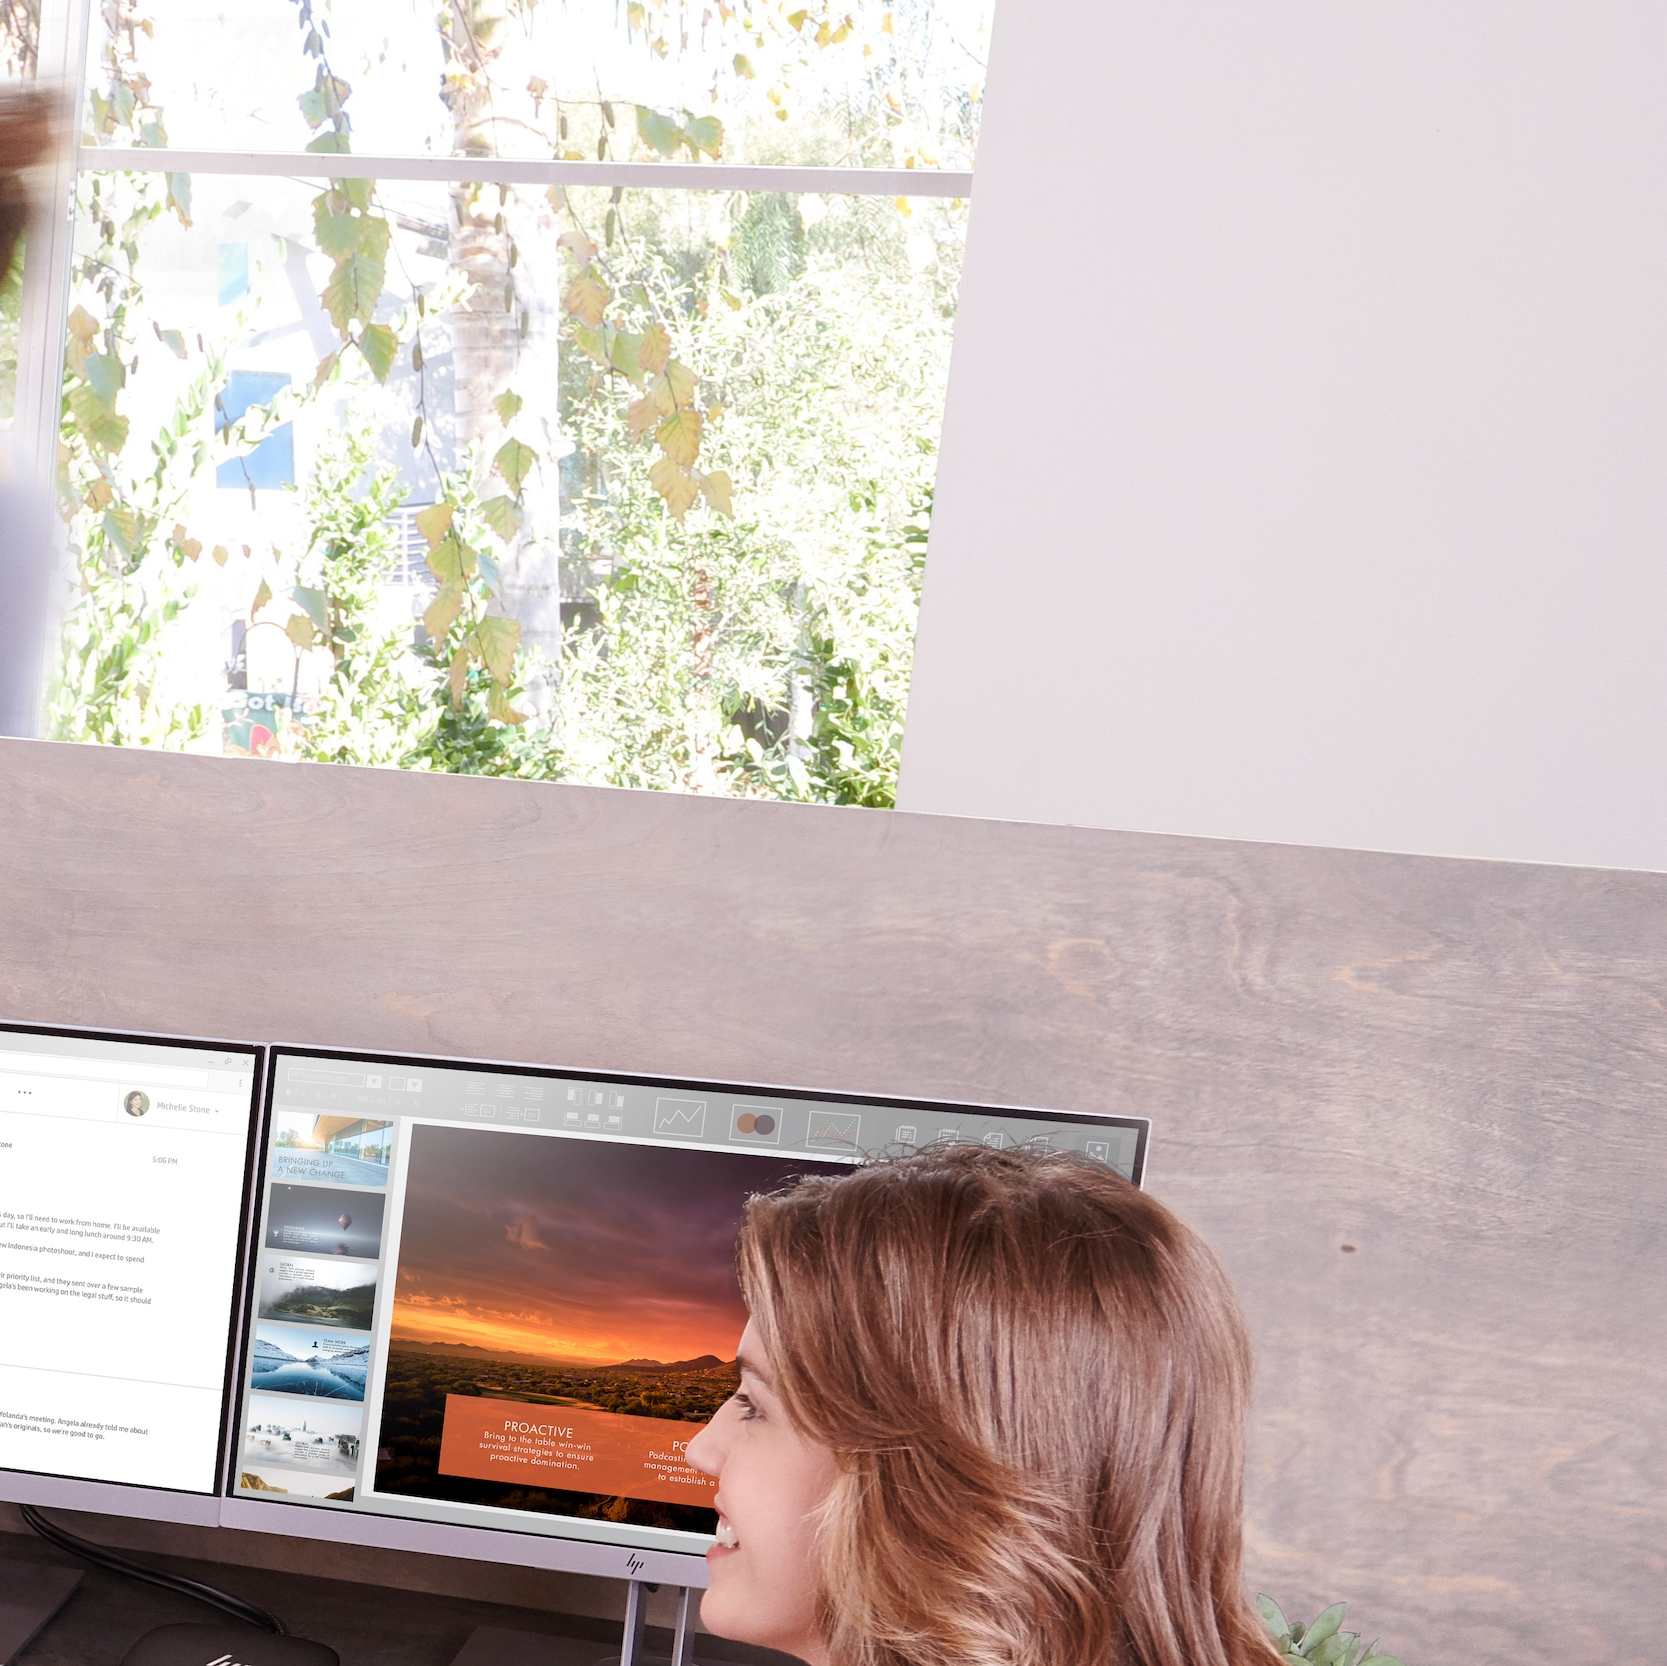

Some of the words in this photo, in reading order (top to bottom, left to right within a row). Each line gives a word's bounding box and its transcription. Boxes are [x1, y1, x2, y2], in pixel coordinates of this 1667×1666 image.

[157, 1101, 187, 1112] Michelle
[189, 1104, 211, 1114] Stone
[152, 1156, 167, 1164] 5:06
[167, 1157, 178, 1165] PM
[279, 1156, 320, 1167] BRINGING
[287, 1166, 306, 1175] NEW
[309, 1168, 346, 1179] CHANGE
[504, 1420, 573, 1439] PROACTIVE
[484, 1431, 506, 1443] Bring
[519, 1435, 532, 1444] the
[535, 1437, 556, 1447] table
[559, 1441, 591, 1451] win-win
[479, 1443, 511, 1451] survival
[513, 1446, 553, 1457] strategies
[566, 1453, 594, 1462] ensure
[490, 1454, 528, 1464] proactive
[530, 1456, 580, 1470] domination.
